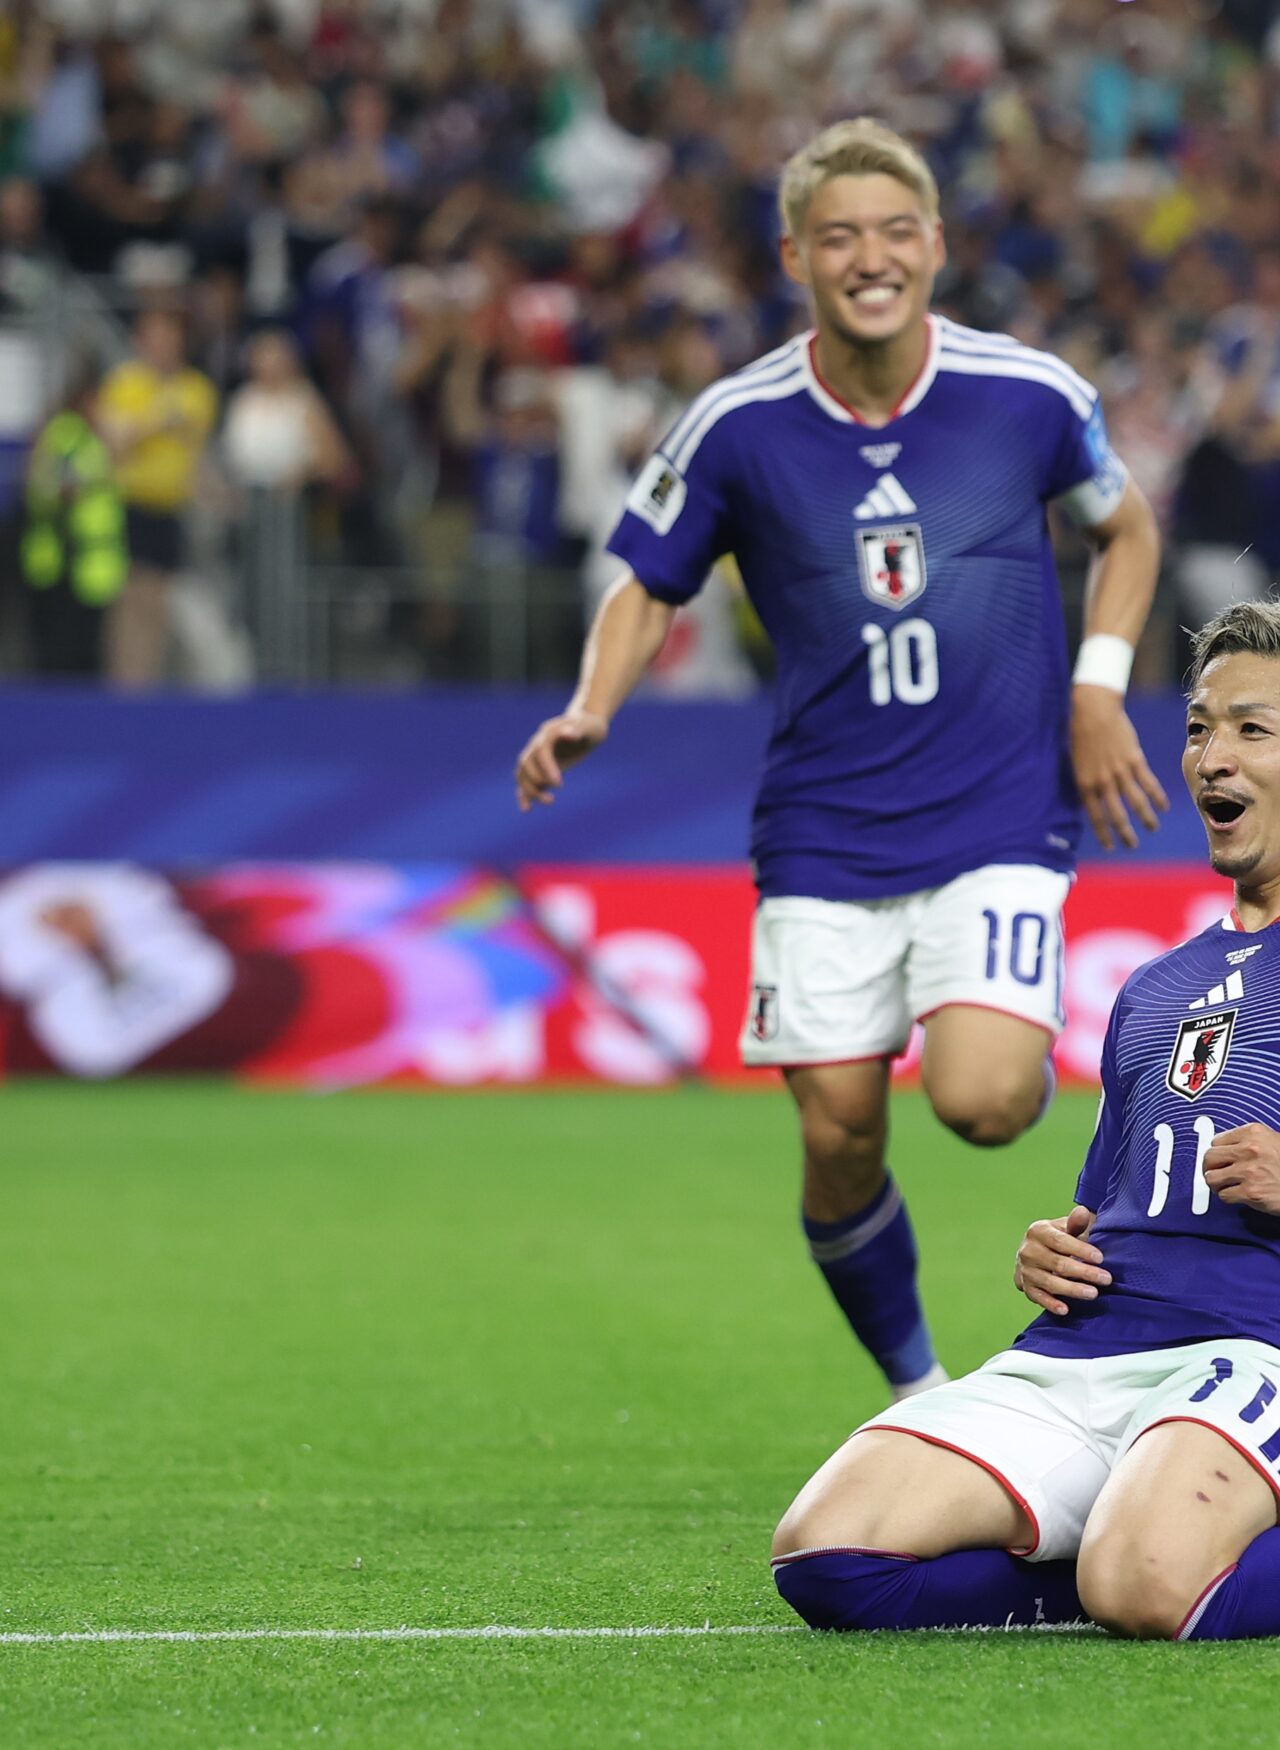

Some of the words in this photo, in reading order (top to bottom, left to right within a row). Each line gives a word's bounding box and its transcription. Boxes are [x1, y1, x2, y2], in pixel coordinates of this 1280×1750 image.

[860, 617, 940, 706] 10
[982, 909, 1047, 985] 10
[1194, 1015, 1224, 1029] JAPAN
[1183, 1070, 1208, 1087] JFA
[1147, 1115, 1215, 1218] 11
[1188, 1357, 1278, 1424] 11
